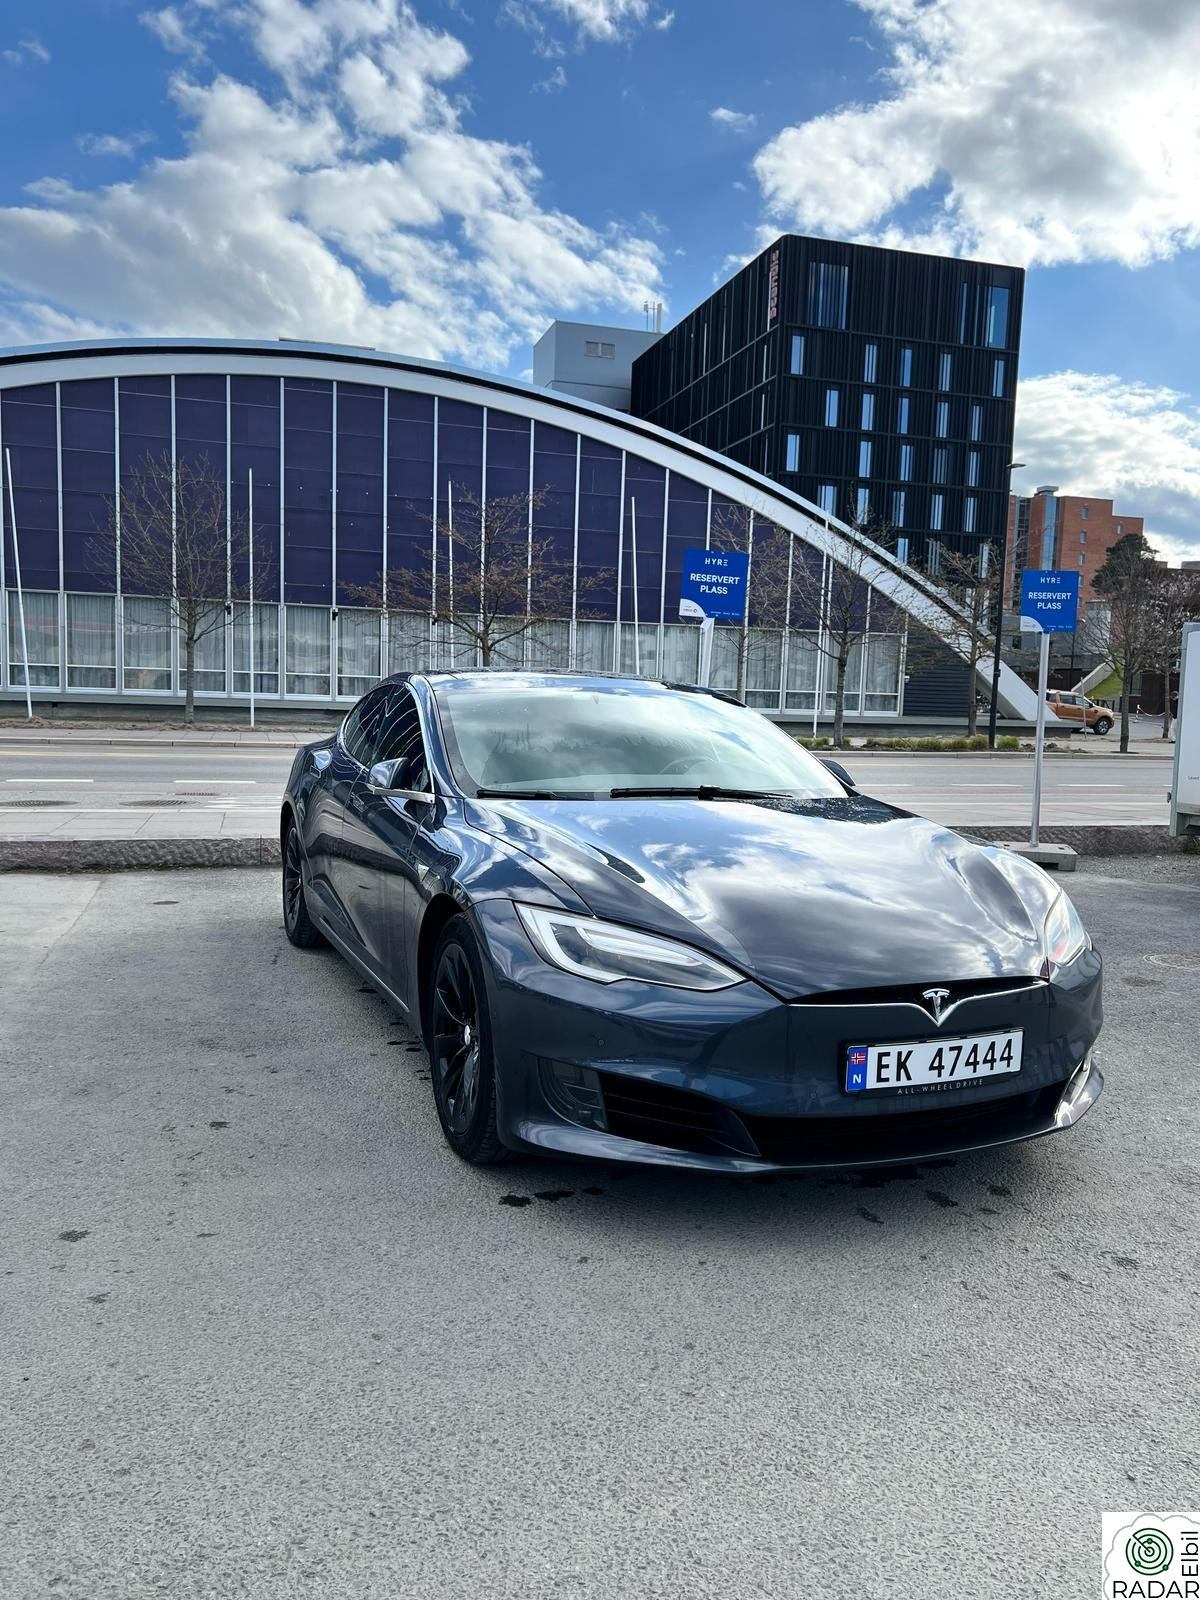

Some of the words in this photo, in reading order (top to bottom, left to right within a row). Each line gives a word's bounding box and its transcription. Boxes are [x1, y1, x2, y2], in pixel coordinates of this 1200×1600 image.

[704, 557, 729, 567] HYRE
[690, 572, 740, 585] RESERVERT
[1040, 576, 1061, 584] HYRE
[700, 585, 728, 595] PLASS
[1028, 591, 1072, 600] RESERVERT
[1037, 602, 1062, 610] PLASS
[876, 1050, 914, 1083] EK
[928, 1038, 1013, 1078] 47444
[852, 1074, 862, 1084] N
[897, 1082, 953, 1095] ALL-WHEEL
[956, 1078, 984, 1089] DRIVE
